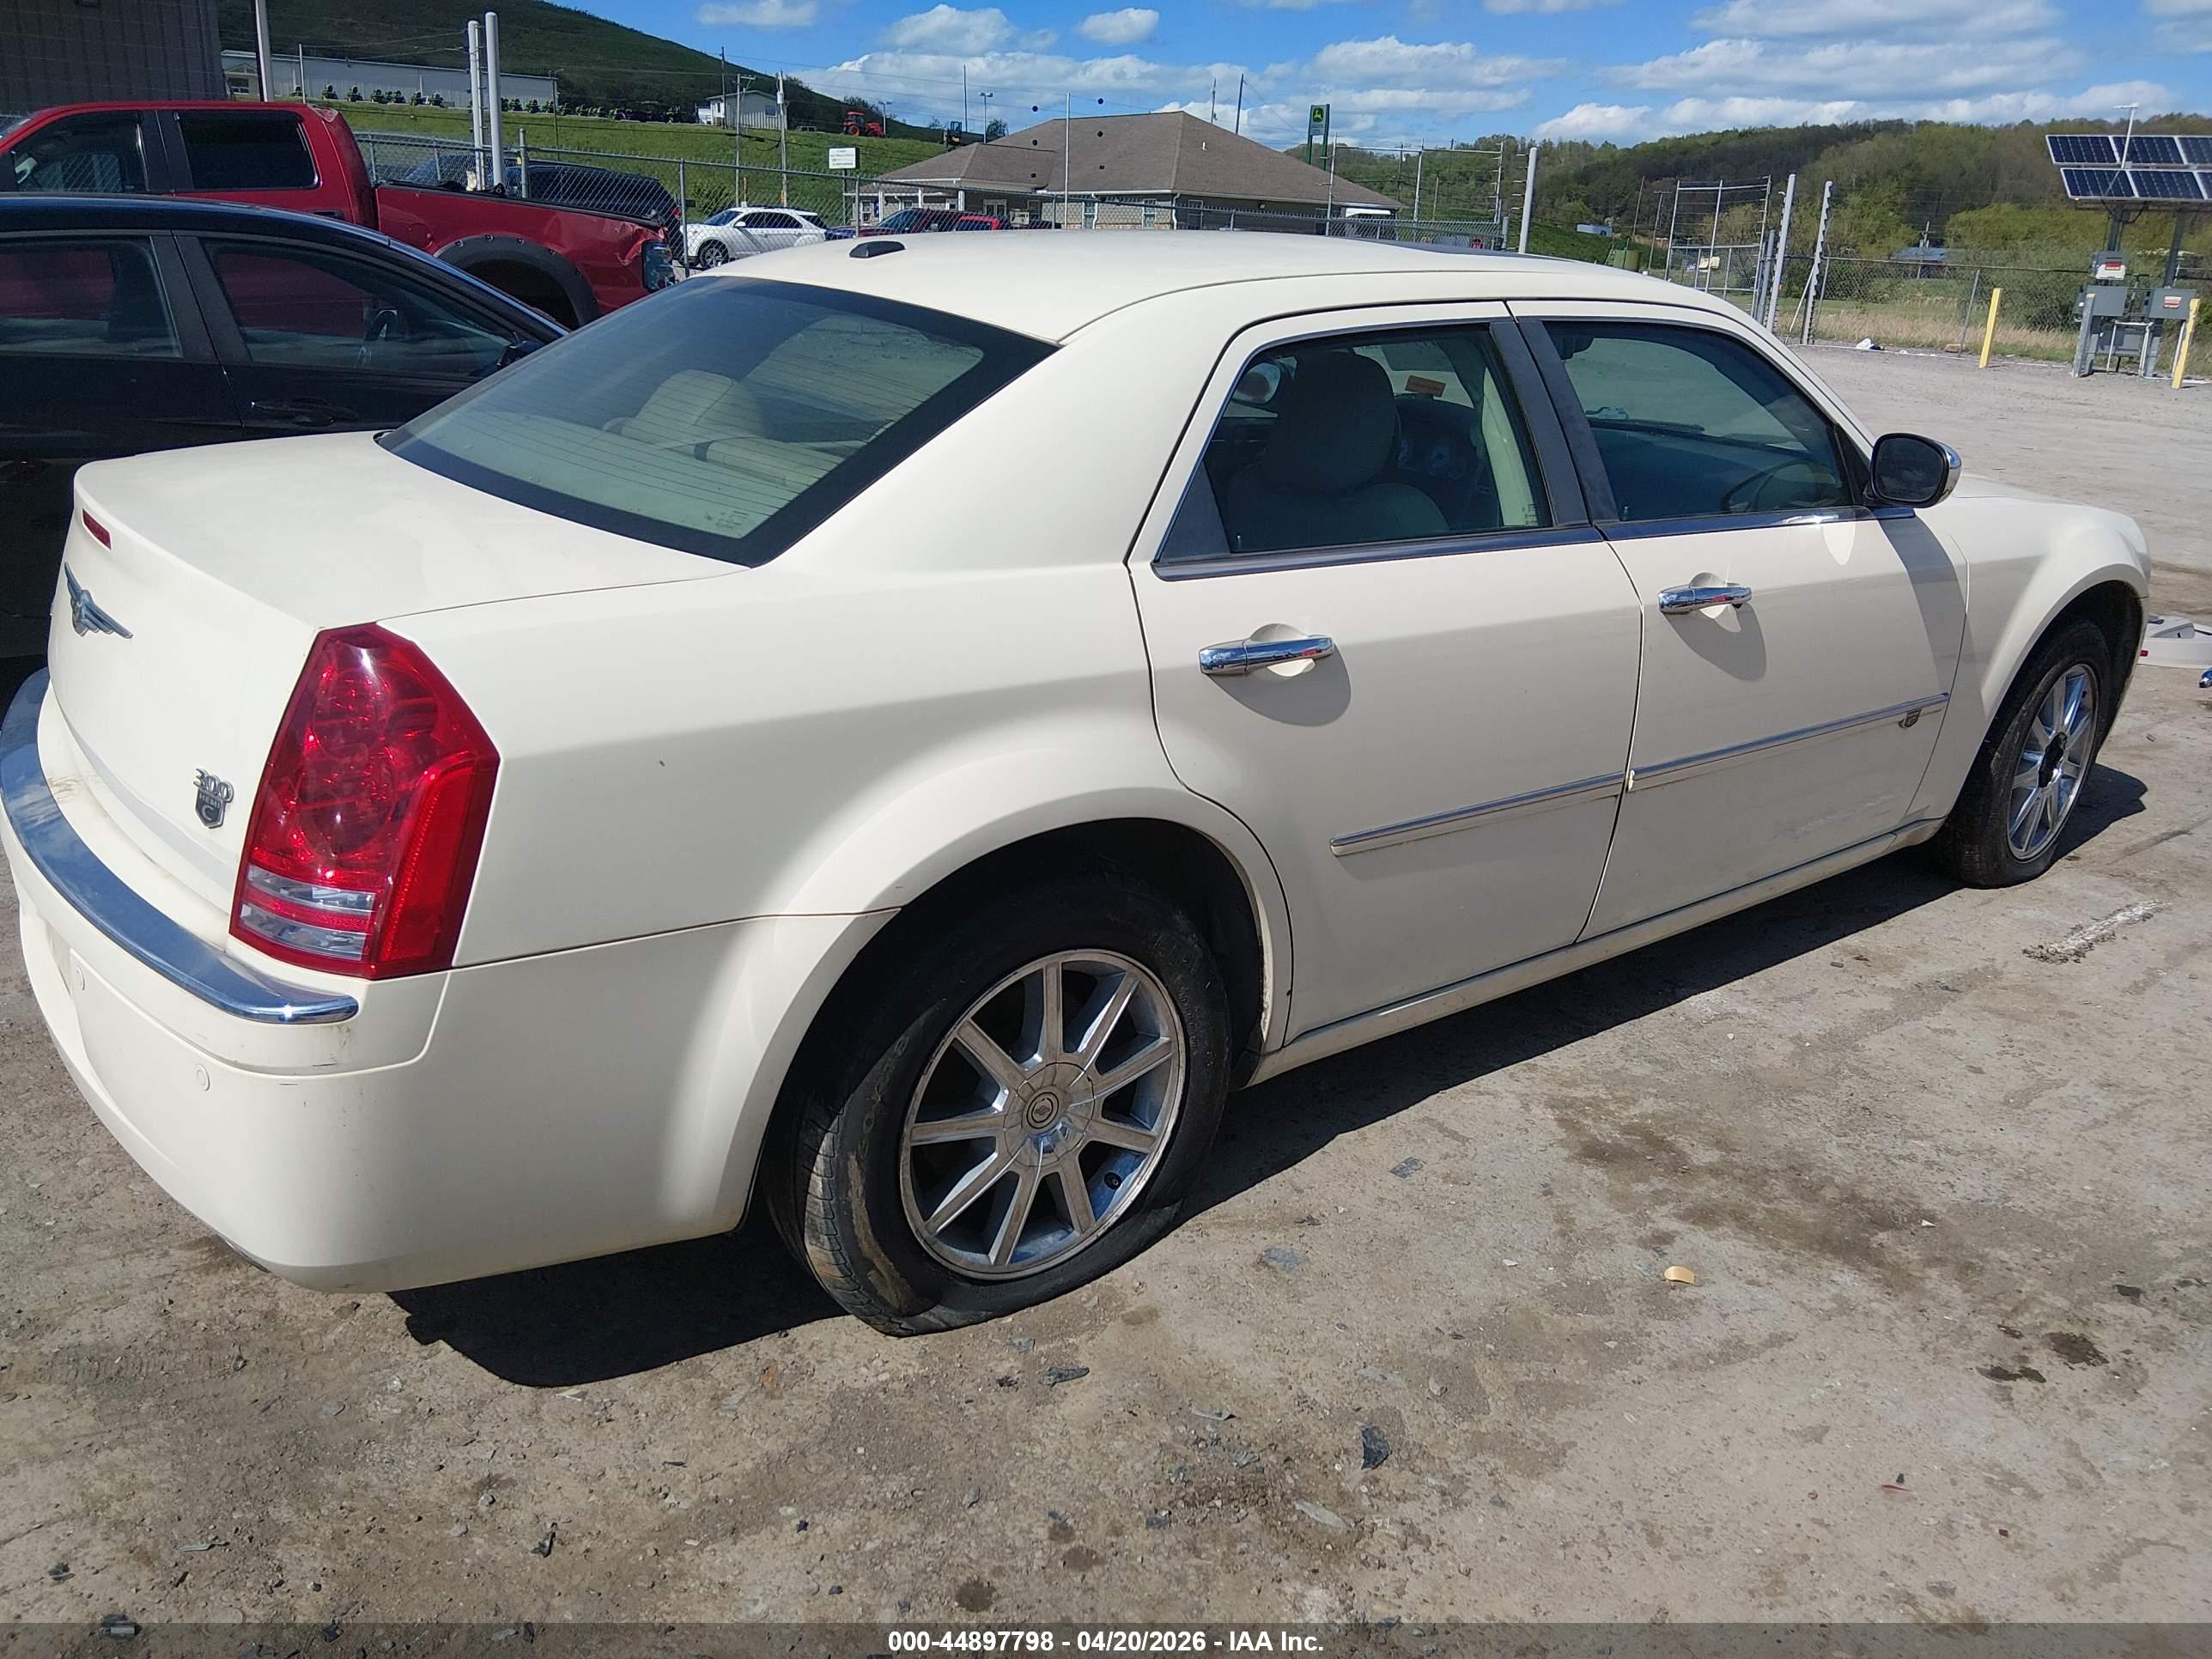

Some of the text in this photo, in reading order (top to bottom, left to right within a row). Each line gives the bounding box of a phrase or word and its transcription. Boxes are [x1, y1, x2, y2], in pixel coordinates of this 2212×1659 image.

[193, 768, 234, 804] 300
[198, 793, 221, 809] HEMI
[201, 804, 215, 822] C
